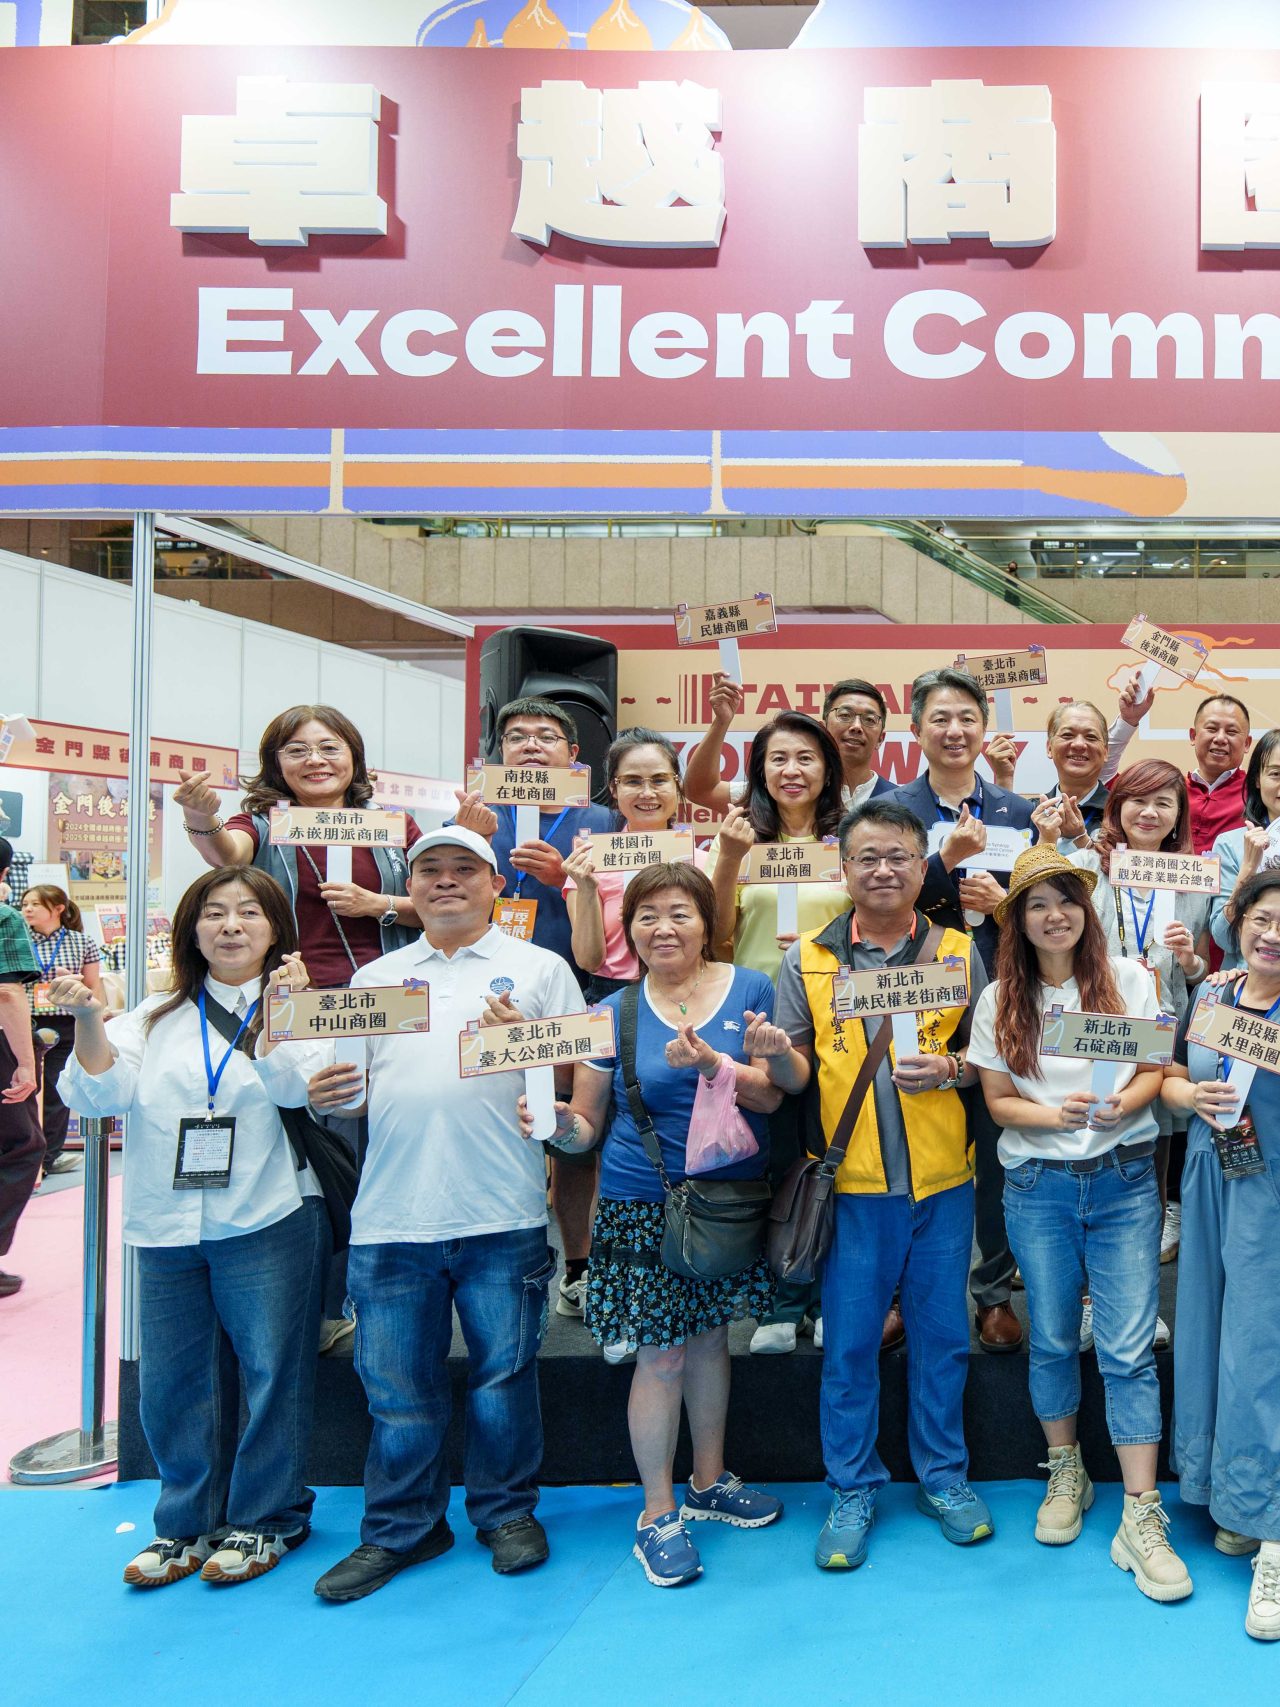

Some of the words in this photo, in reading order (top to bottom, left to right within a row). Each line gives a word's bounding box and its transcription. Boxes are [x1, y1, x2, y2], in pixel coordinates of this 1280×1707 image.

[196, 285, 854, 379] Excellent
[704, 605, 741, 621] 嘉義縣
[701, 619, 748, 637] 民雄商圈
[1150, 631, 1180, 652] 金門縣
[1140, 639, 1179, 668] 後浦商圈
[983, 657, 1016, 672] 臺北市
[974, 668, 1041, 686] 北投溫泉商圈
[504, 770, 549, 784] 南投縣
[496, 786, 556, 801] 在地商圈
[315, 811, 364, 825] 臺南市
[289, 826, 389, 842] 赤嵌朋派商圈
[610, 834, 654, 850] 桃園市
[602, 850, 662, 867] 健行商圈
[766, 847, 805, 861] 臺北市
[759, 864, 812, 878] 圓山商圈
[1131, 855, 1203, 872] 臺灣商圈文化
[1118, 868, 1215, 887] 觀光產業聯合總會
[876, 970, 924, 989] 新北市
[318, 992, 377, 1011] 臺北市
[836, 984, 967, 1012] 三峽民權老街商圈
[309, 1011, 388, 1032] 中山商圈
[1083, 1018, 1133, 1037] 新北市
[1231, 1016, 1280, 1044] 南投縣
[507, 1022, 563, 1044] 臺北市
[479, 1037, 592, 1067] 臺大公館商圈
[1073, 1037, 1139, 1057] 石碇商圈
